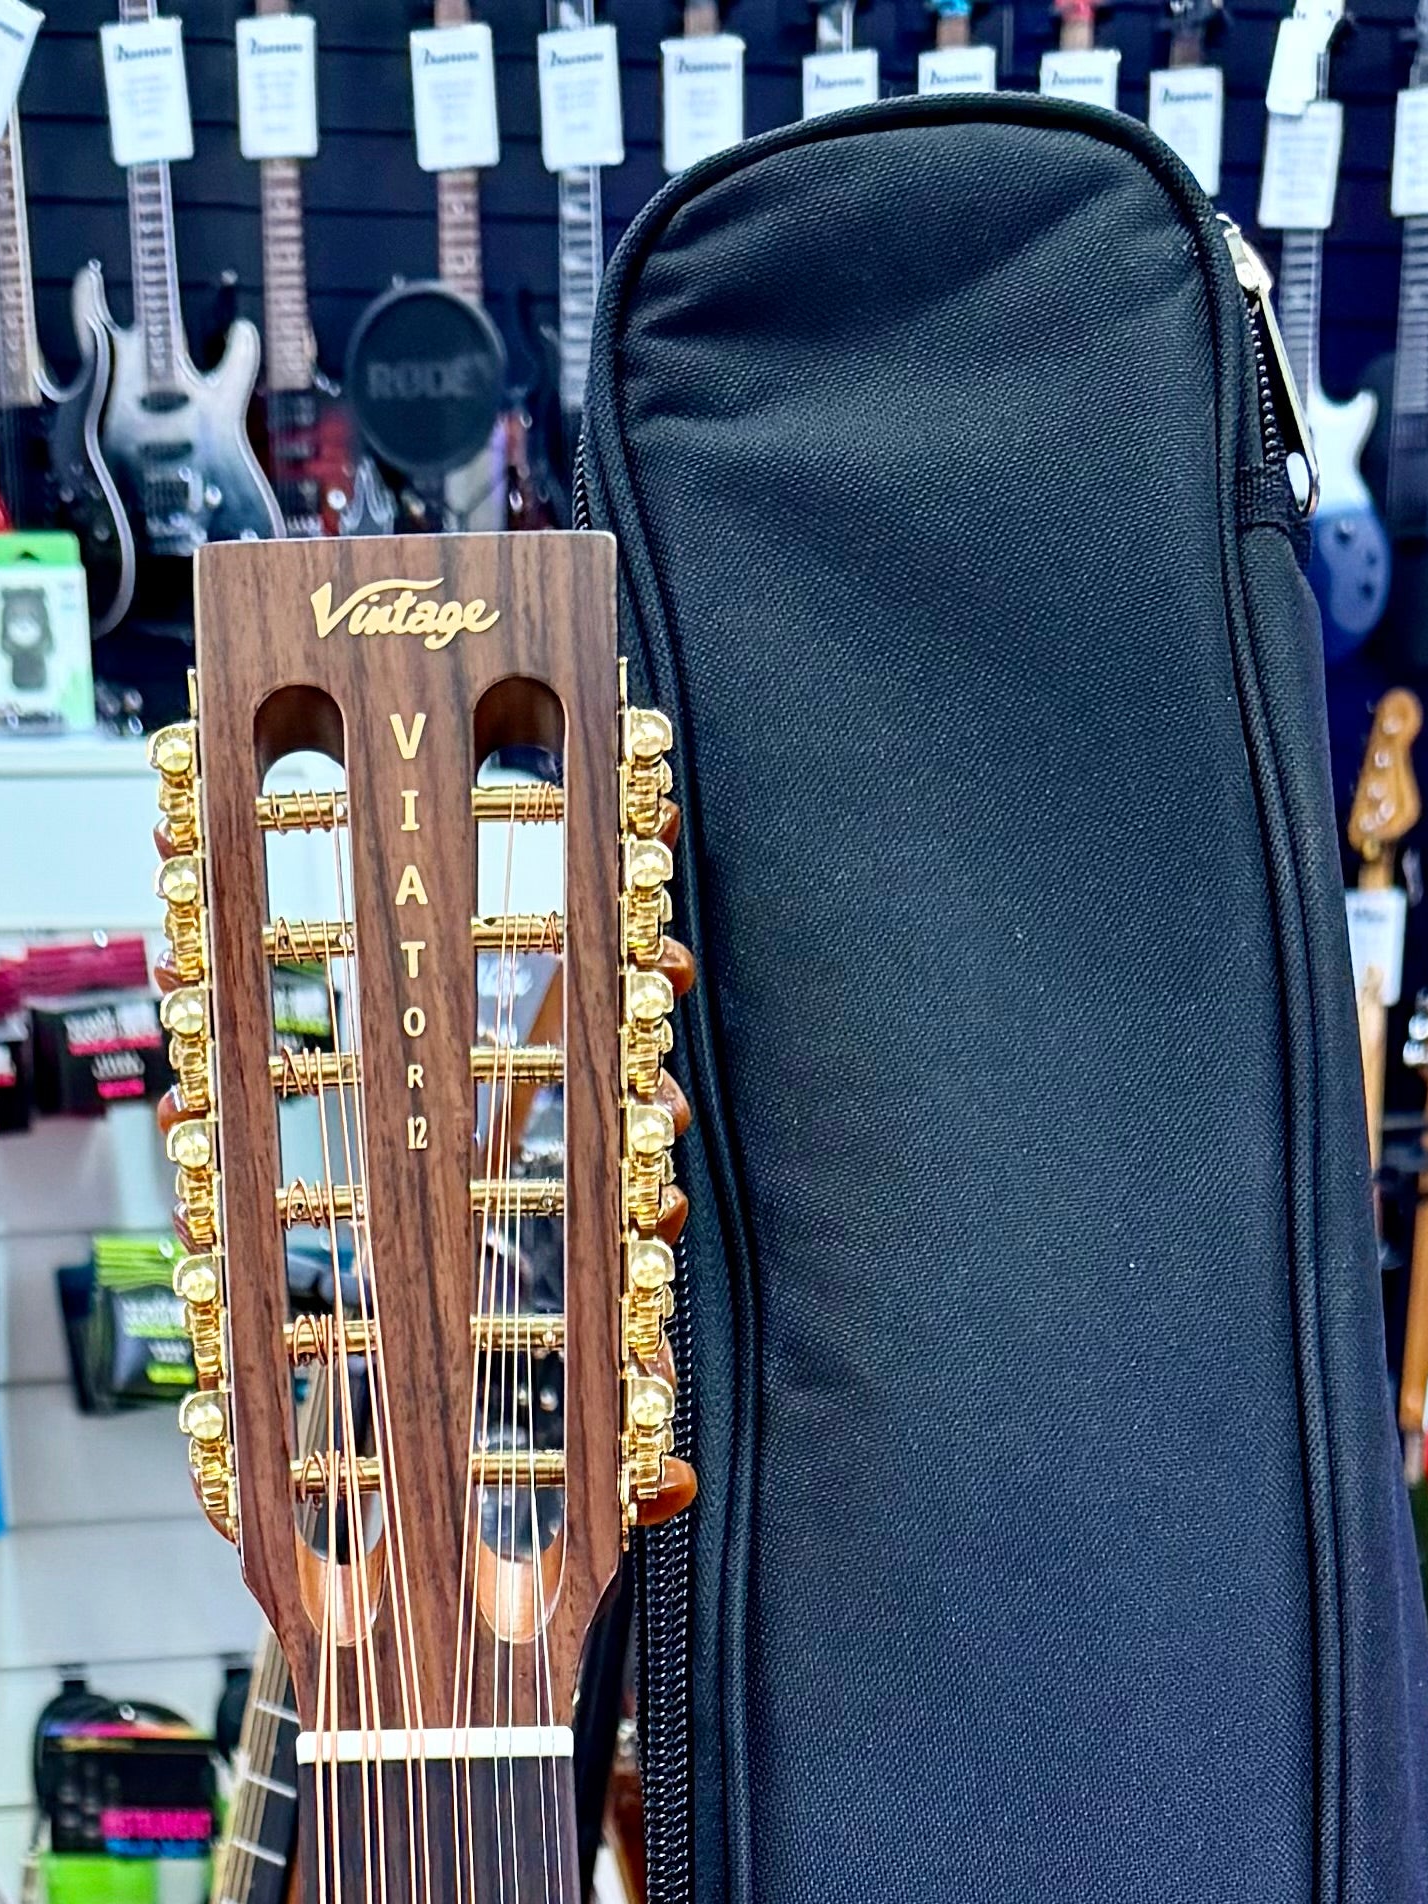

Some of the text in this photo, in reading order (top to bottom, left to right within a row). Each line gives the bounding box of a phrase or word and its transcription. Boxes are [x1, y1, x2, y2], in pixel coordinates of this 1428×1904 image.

[310, 576, 500, 651] Vintage
[389, 712, 430, 1151] VIATOR 12
